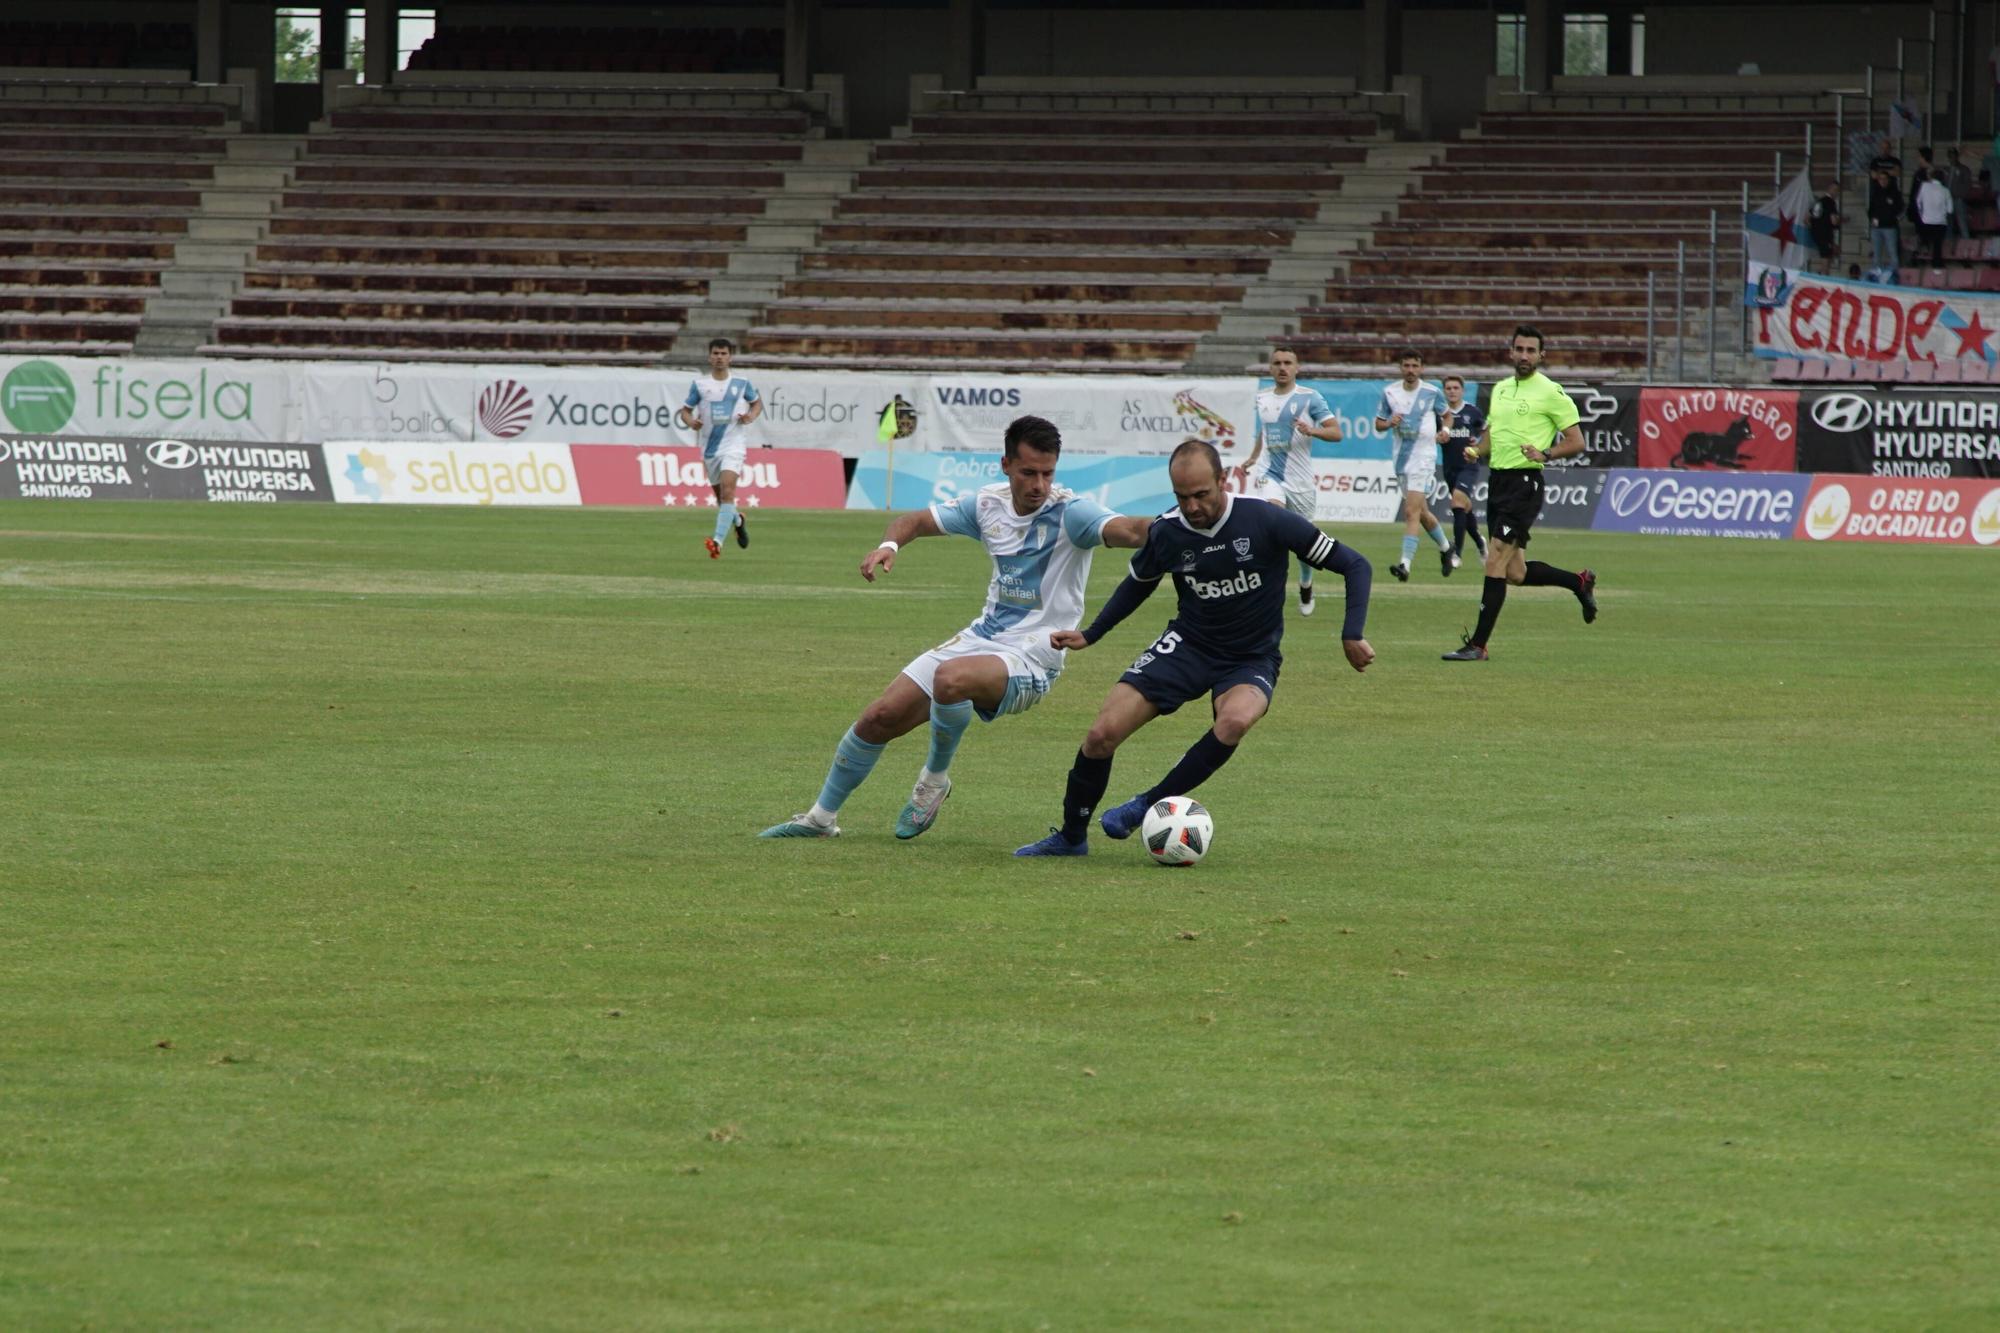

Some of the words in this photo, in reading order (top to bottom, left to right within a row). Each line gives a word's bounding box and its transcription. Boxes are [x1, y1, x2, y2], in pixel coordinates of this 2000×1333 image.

[93, 365, 252, 421] fisela
[937, 388, 1021, 406] VAMOS
[546, 394, 691, 431] Xacobeo
[1121, 399, 1142, 415] AS
[1643, 420, 1660, 440] O
[1662, 390, 1716, 422] GATO
[1724, 392, 1793, 441] NEGRO
[1875, 400, 2000, 430] HYUNDA
[1121, 416, 1199, 433] CANCELAS
[11, 440, 127, 463] HYUNDAI
[200, 446, 310, 469] HYUNDAI
[1873, 432, 2000, 460] HYUPERSA
[17, 463, 132, 485] HYUPERSA
[407, 450, 566, 505] salgado
[637, 452, 780, 488] Maou
[939, 456, 999, 478] Cobre
[1872, 461, 1951, 479] SANTIAGO
[20, 485, 92, 498] SANTIAGO
[204, 469, 315, 491] HYUPERSA
[1314, 475, 1399, 493] OSCAR
[208, 490, 276, 502] SANTIAGO
[1649, 478, 1793, 522] Geseme
[1869, 488, 1887, 510] O
[1890, 489, 1924, 511] REI
[1926, 490, 1960, 513] DO
[1846, 514, 1966, 538] BOCADILLO
[1001, 584, 1036, 600] Rafael
[1149, 630, 1183, 655] 5
